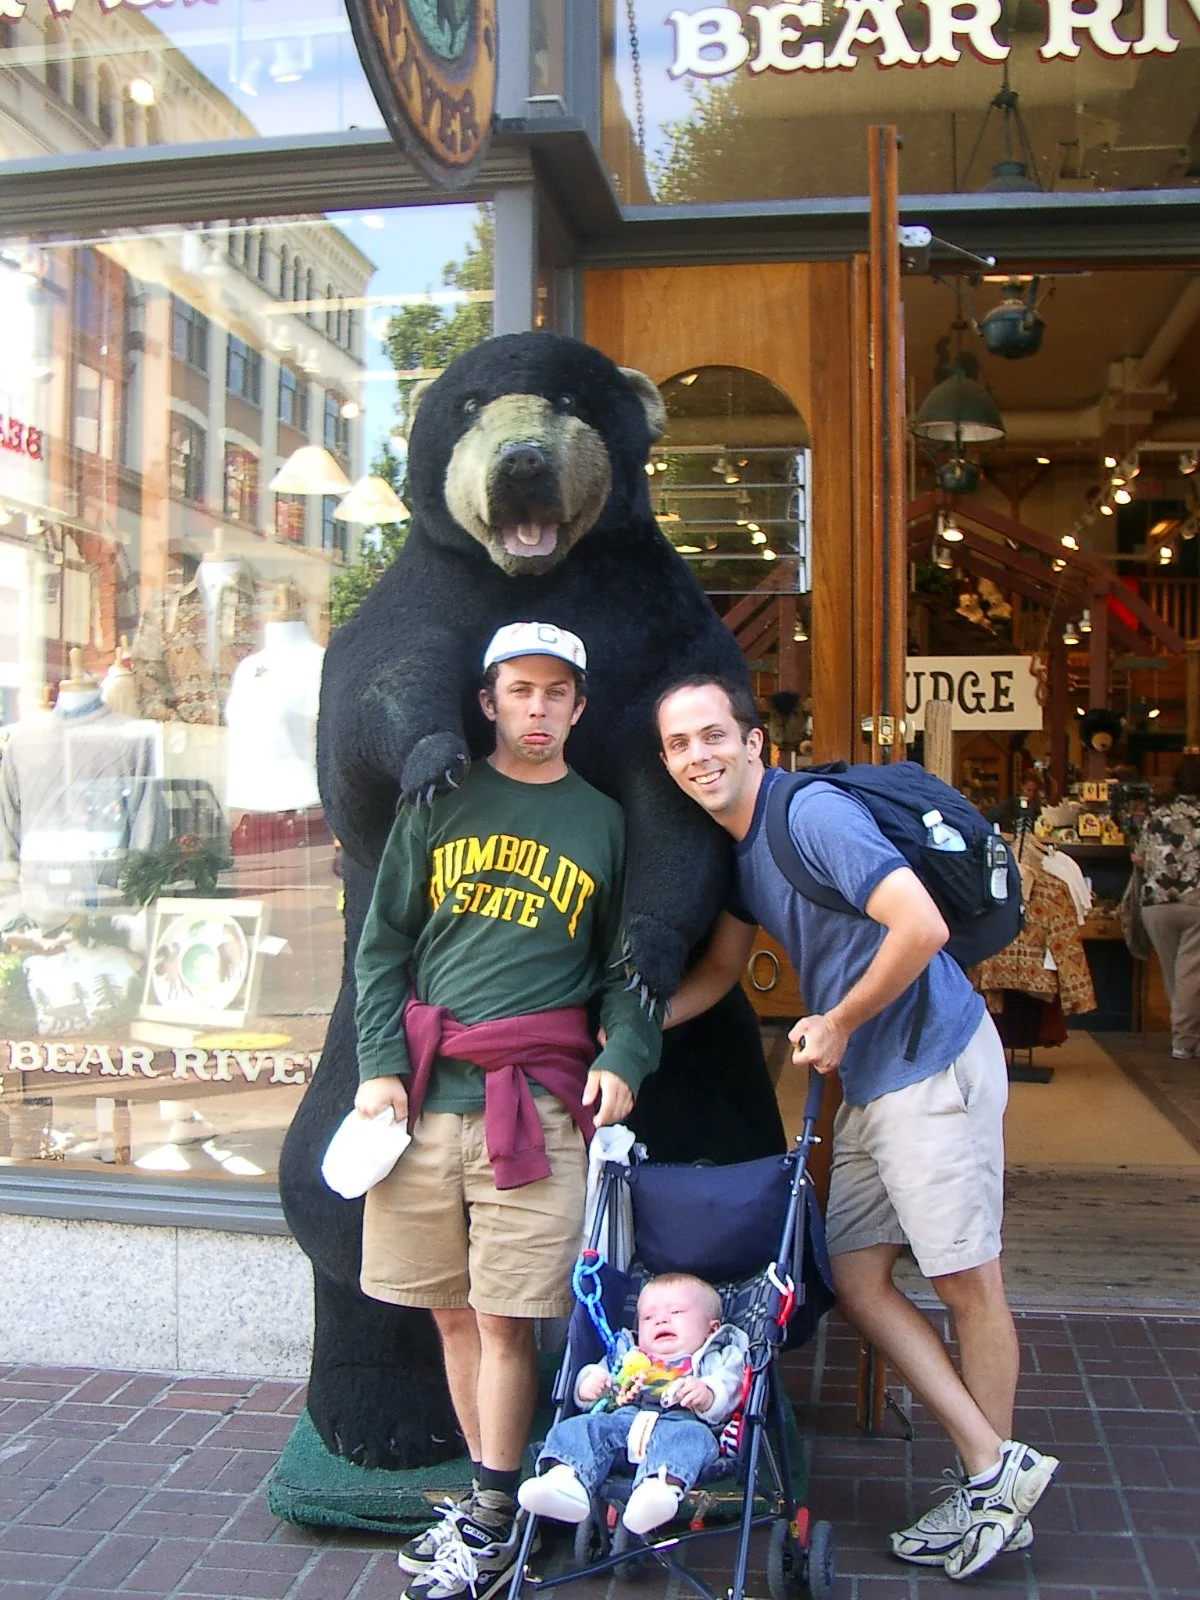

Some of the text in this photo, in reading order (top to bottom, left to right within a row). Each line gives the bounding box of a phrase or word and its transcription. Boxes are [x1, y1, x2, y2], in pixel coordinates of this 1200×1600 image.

[664, 0, 1200, 81] BEAR RI
[537, 626, 558, 645] C
[428, 833, 597, 941] HUMBOLDT
[451, 881, 546, 930] STATE
[7, 1039, 159, 1079] BEAR
